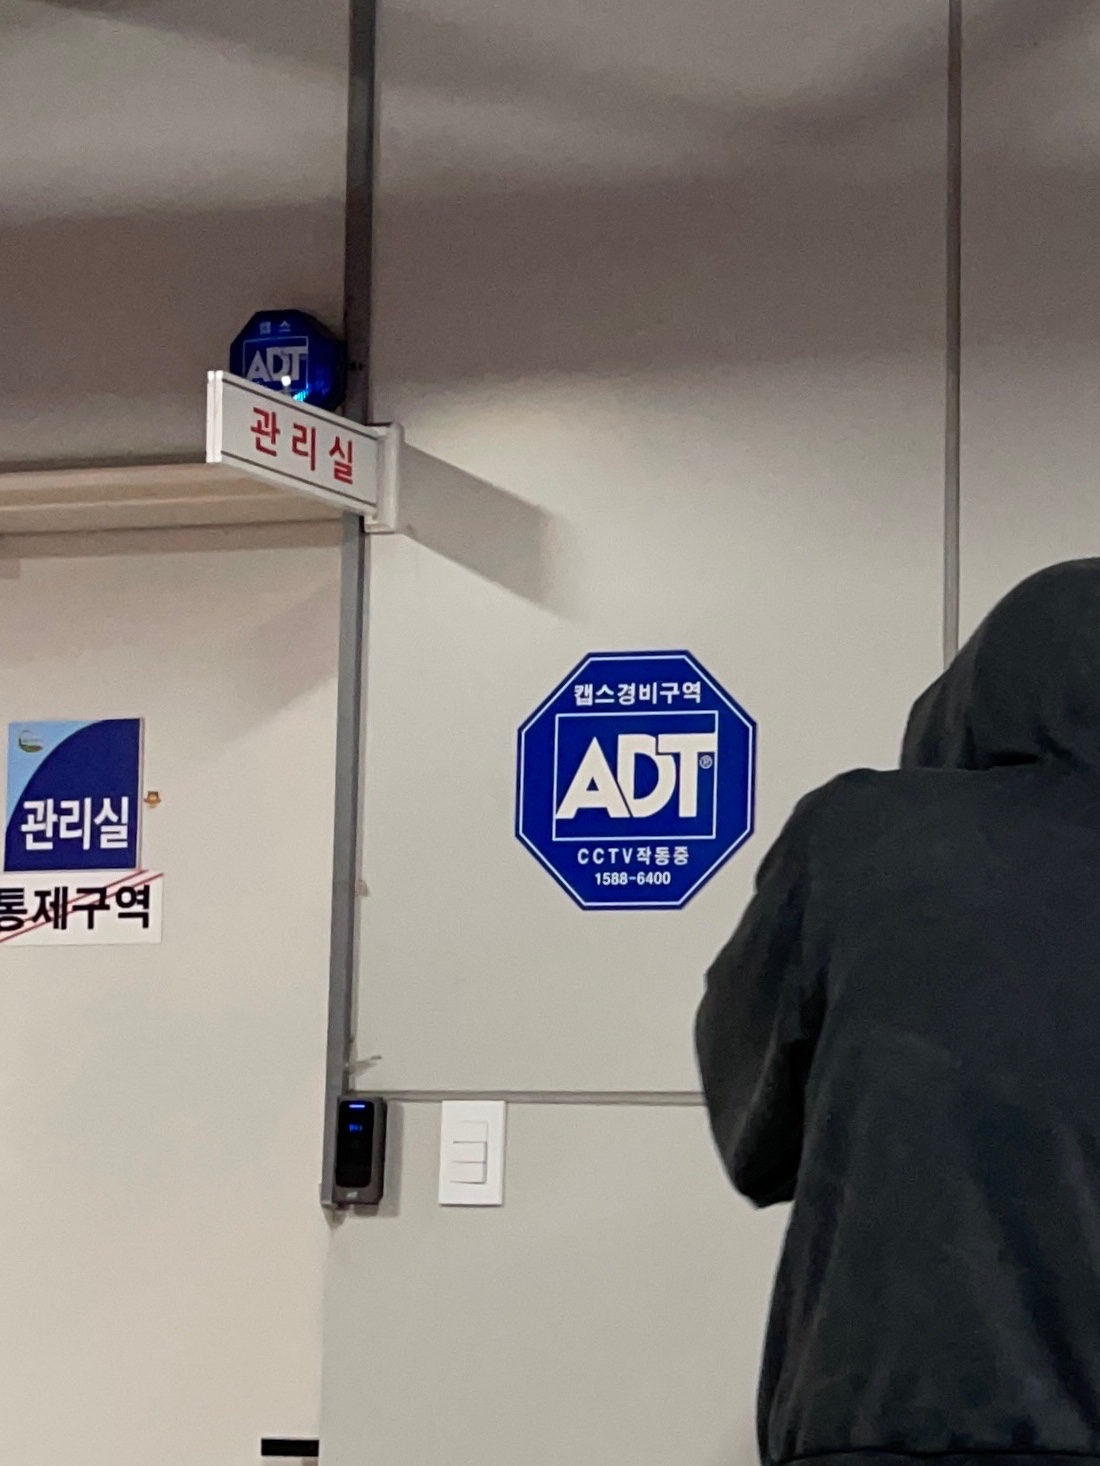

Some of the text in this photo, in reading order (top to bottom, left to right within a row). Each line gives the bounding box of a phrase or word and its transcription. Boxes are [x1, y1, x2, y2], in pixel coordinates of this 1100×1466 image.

[246, 345, 308, 382] ADT
[250, 406, 353, 485] 관리실
[574, 681, 701, 706] 캡스경비구역
[555, 732, 717, 819] ADT
[21, 796, 129, 850] 관리실
[594, 871, 671, 886] 1588-6400
[0, 884, 151, 931] 통제구역
